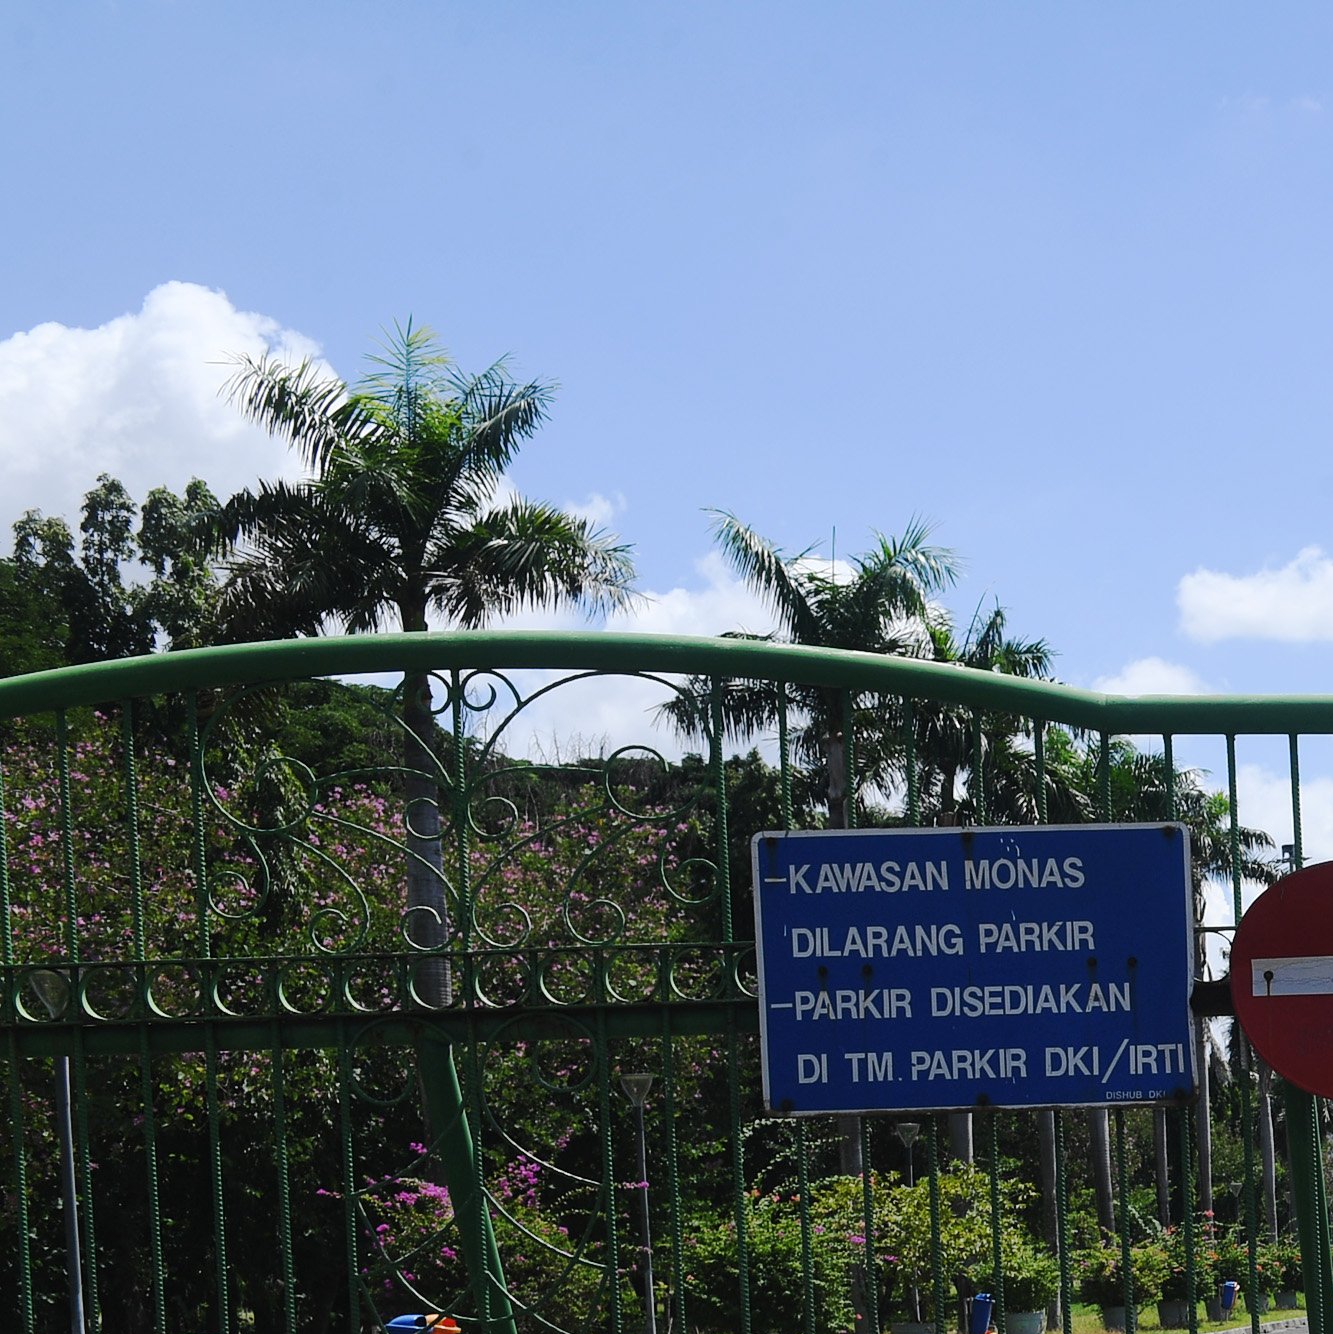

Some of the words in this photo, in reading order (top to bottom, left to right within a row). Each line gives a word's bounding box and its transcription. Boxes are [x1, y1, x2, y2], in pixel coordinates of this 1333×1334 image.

[964, 857, 1085, 890] MONAS
[791, 923, 964, 958] DILARANG
[978, 921, 1096, 953] PARKIR
[930, 982, 1131, 1018] DISEDIAKAN
[797, 1053, 828, 1084] DI
[911, 1048, 1027, 1081] PARKIR
[1045, 1039, 1185, 1084] DKI/IRTI
[1106, 1090, 1143, 1100] DISHUB
